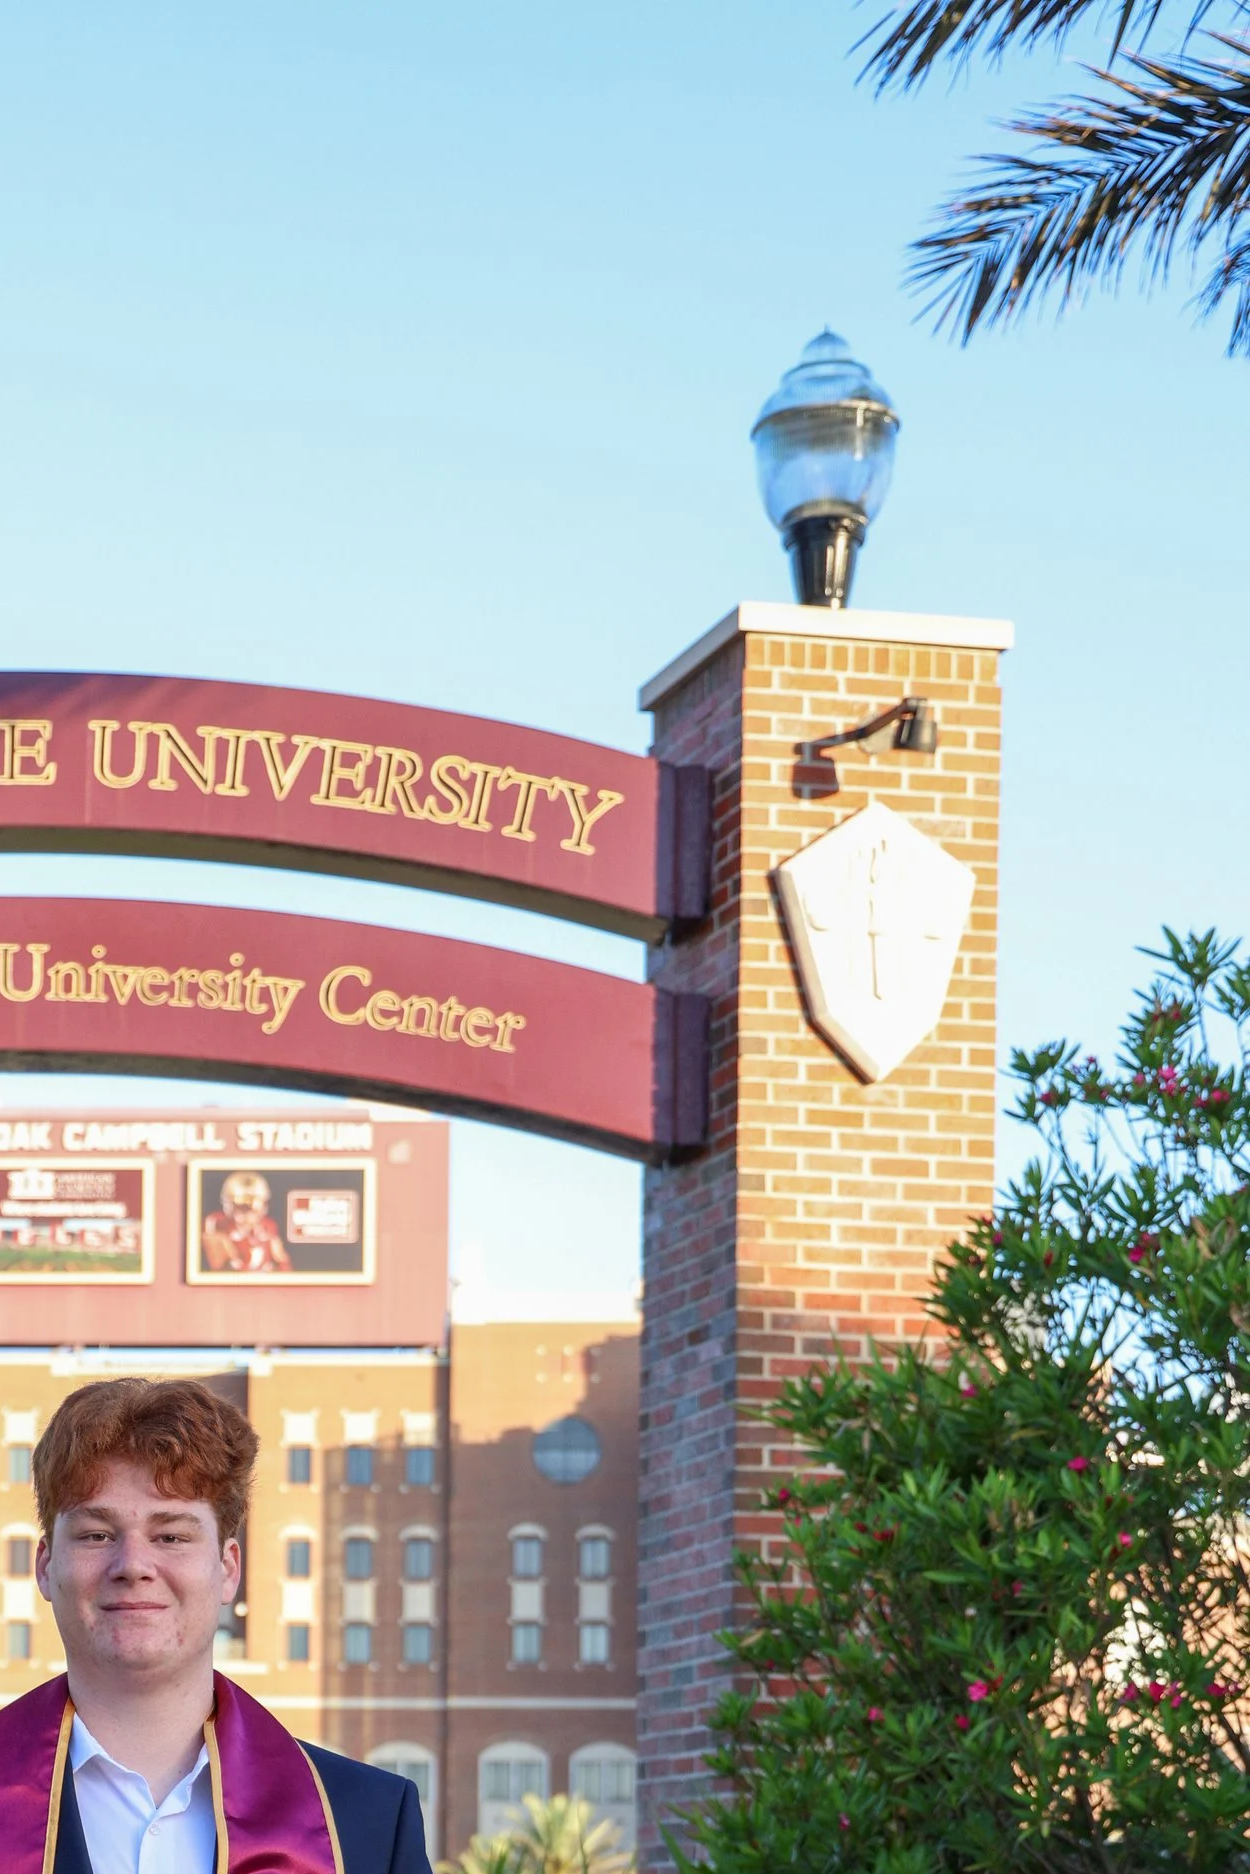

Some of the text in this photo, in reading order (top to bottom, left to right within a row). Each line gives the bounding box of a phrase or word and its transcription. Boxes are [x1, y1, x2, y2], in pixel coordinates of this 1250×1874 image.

[88, 719, 625, 856] UNIVERSITY
[318, 964, 527, 1054] Center
[62, 1123, 226, 1152] CAMPBELL
[237, 1122, 374, 1152] STADIUM
